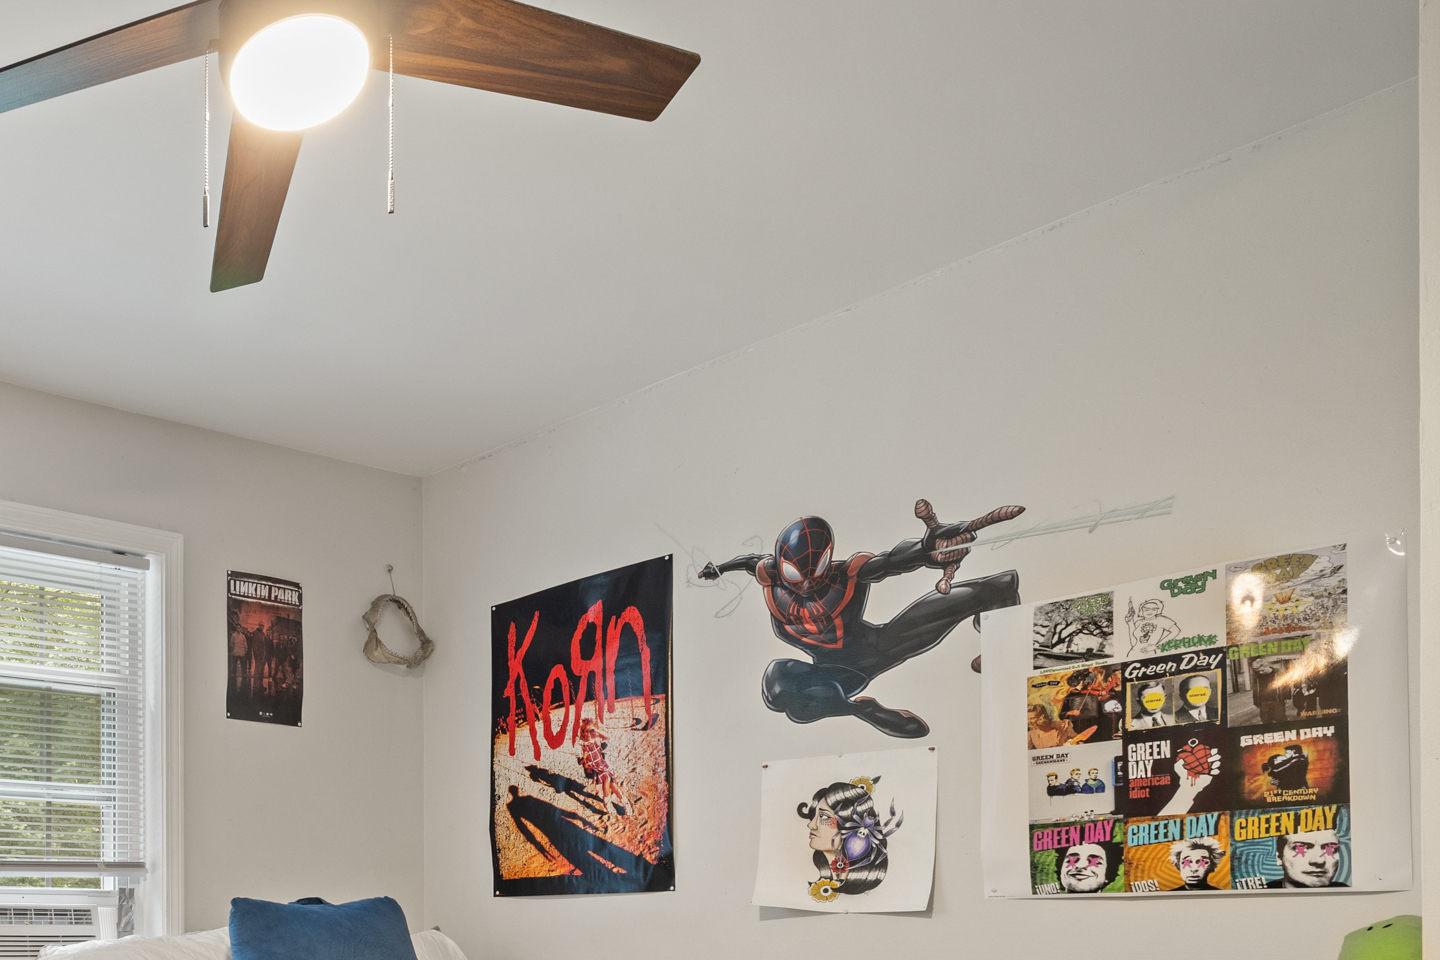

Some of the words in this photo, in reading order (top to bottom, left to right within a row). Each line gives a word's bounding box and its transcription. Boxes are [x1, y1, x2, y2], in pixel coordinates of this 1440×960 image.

[229, 579, 269, 600] LINKIN
[271, 585, 300, 606] PARK
[1228, 641, 1279, 660] GREEN
[1280, 637, 1311, 654] DAY
[1124, 661, 1177, 679] Green
[1179, 653, 1223, 671] Day
[1240, 729, 1297, 748] GREEN
[1299, 725, 1335, 740] DAY
[1032, 754, 1054, 762] GREEN
[1127, 740, 1171, 762] GREEN
[1128, 759, 1153, 780] DAY
[1129, 774, 1171, 788] american
[1282, 787, 1319, 796] CENTURY
[1129, 787, 1150, 799] idiot
[1266, 794, 1316, 803] BREAKDOWN
[1127, 820, 1181, 847] GREEN
[1185, 812, 1219, 839] DAY
[1234, 811, 1295, 841] GREEN
[1299, 804, 1337, 832] DAY
[1032, 824, 1081, 852] GREEN
[1084, 819, 1114, 844] DAY
